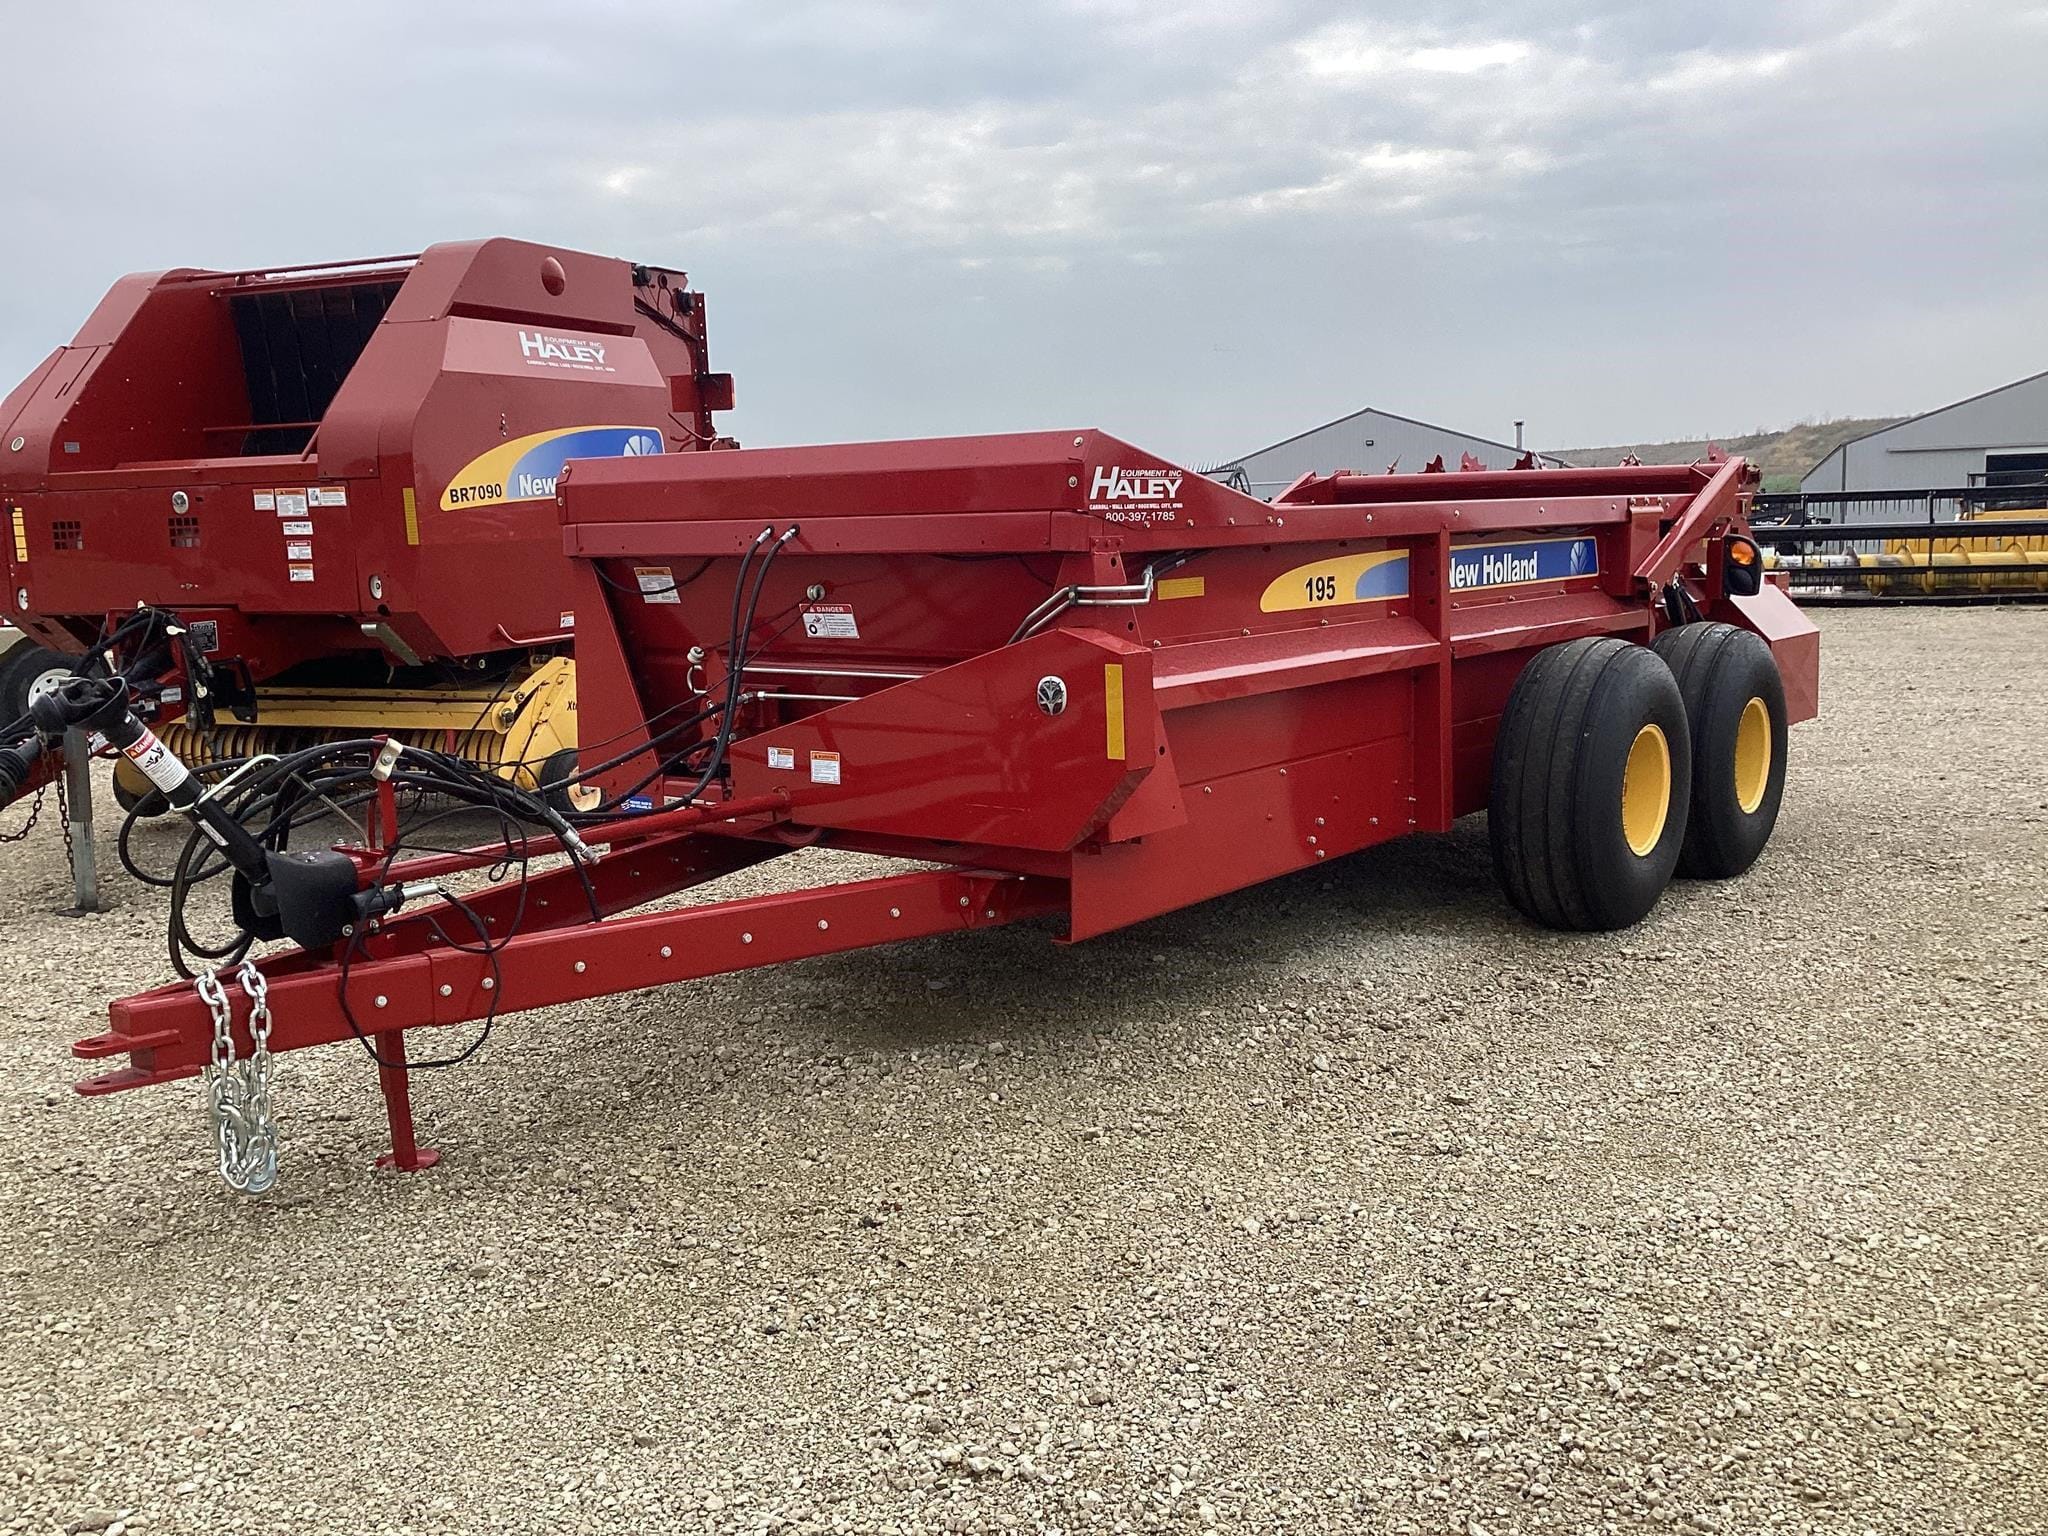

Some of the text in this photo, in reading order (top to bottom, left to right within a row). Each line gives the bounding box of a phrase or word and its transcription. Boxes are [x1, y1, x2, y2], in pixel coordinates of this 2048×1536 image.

[518, 331, 605, 364] HALEY
[1089, 466, 1183, 499] HALEY
[1120, 469, 1183, 477] EQUIPMENT INC
[450, 474, 557, 504] BR7090 New
[1105, 511, 1175, 522] 800-397-1785
[1305, 550, 1538, 602] 195 New Holland
